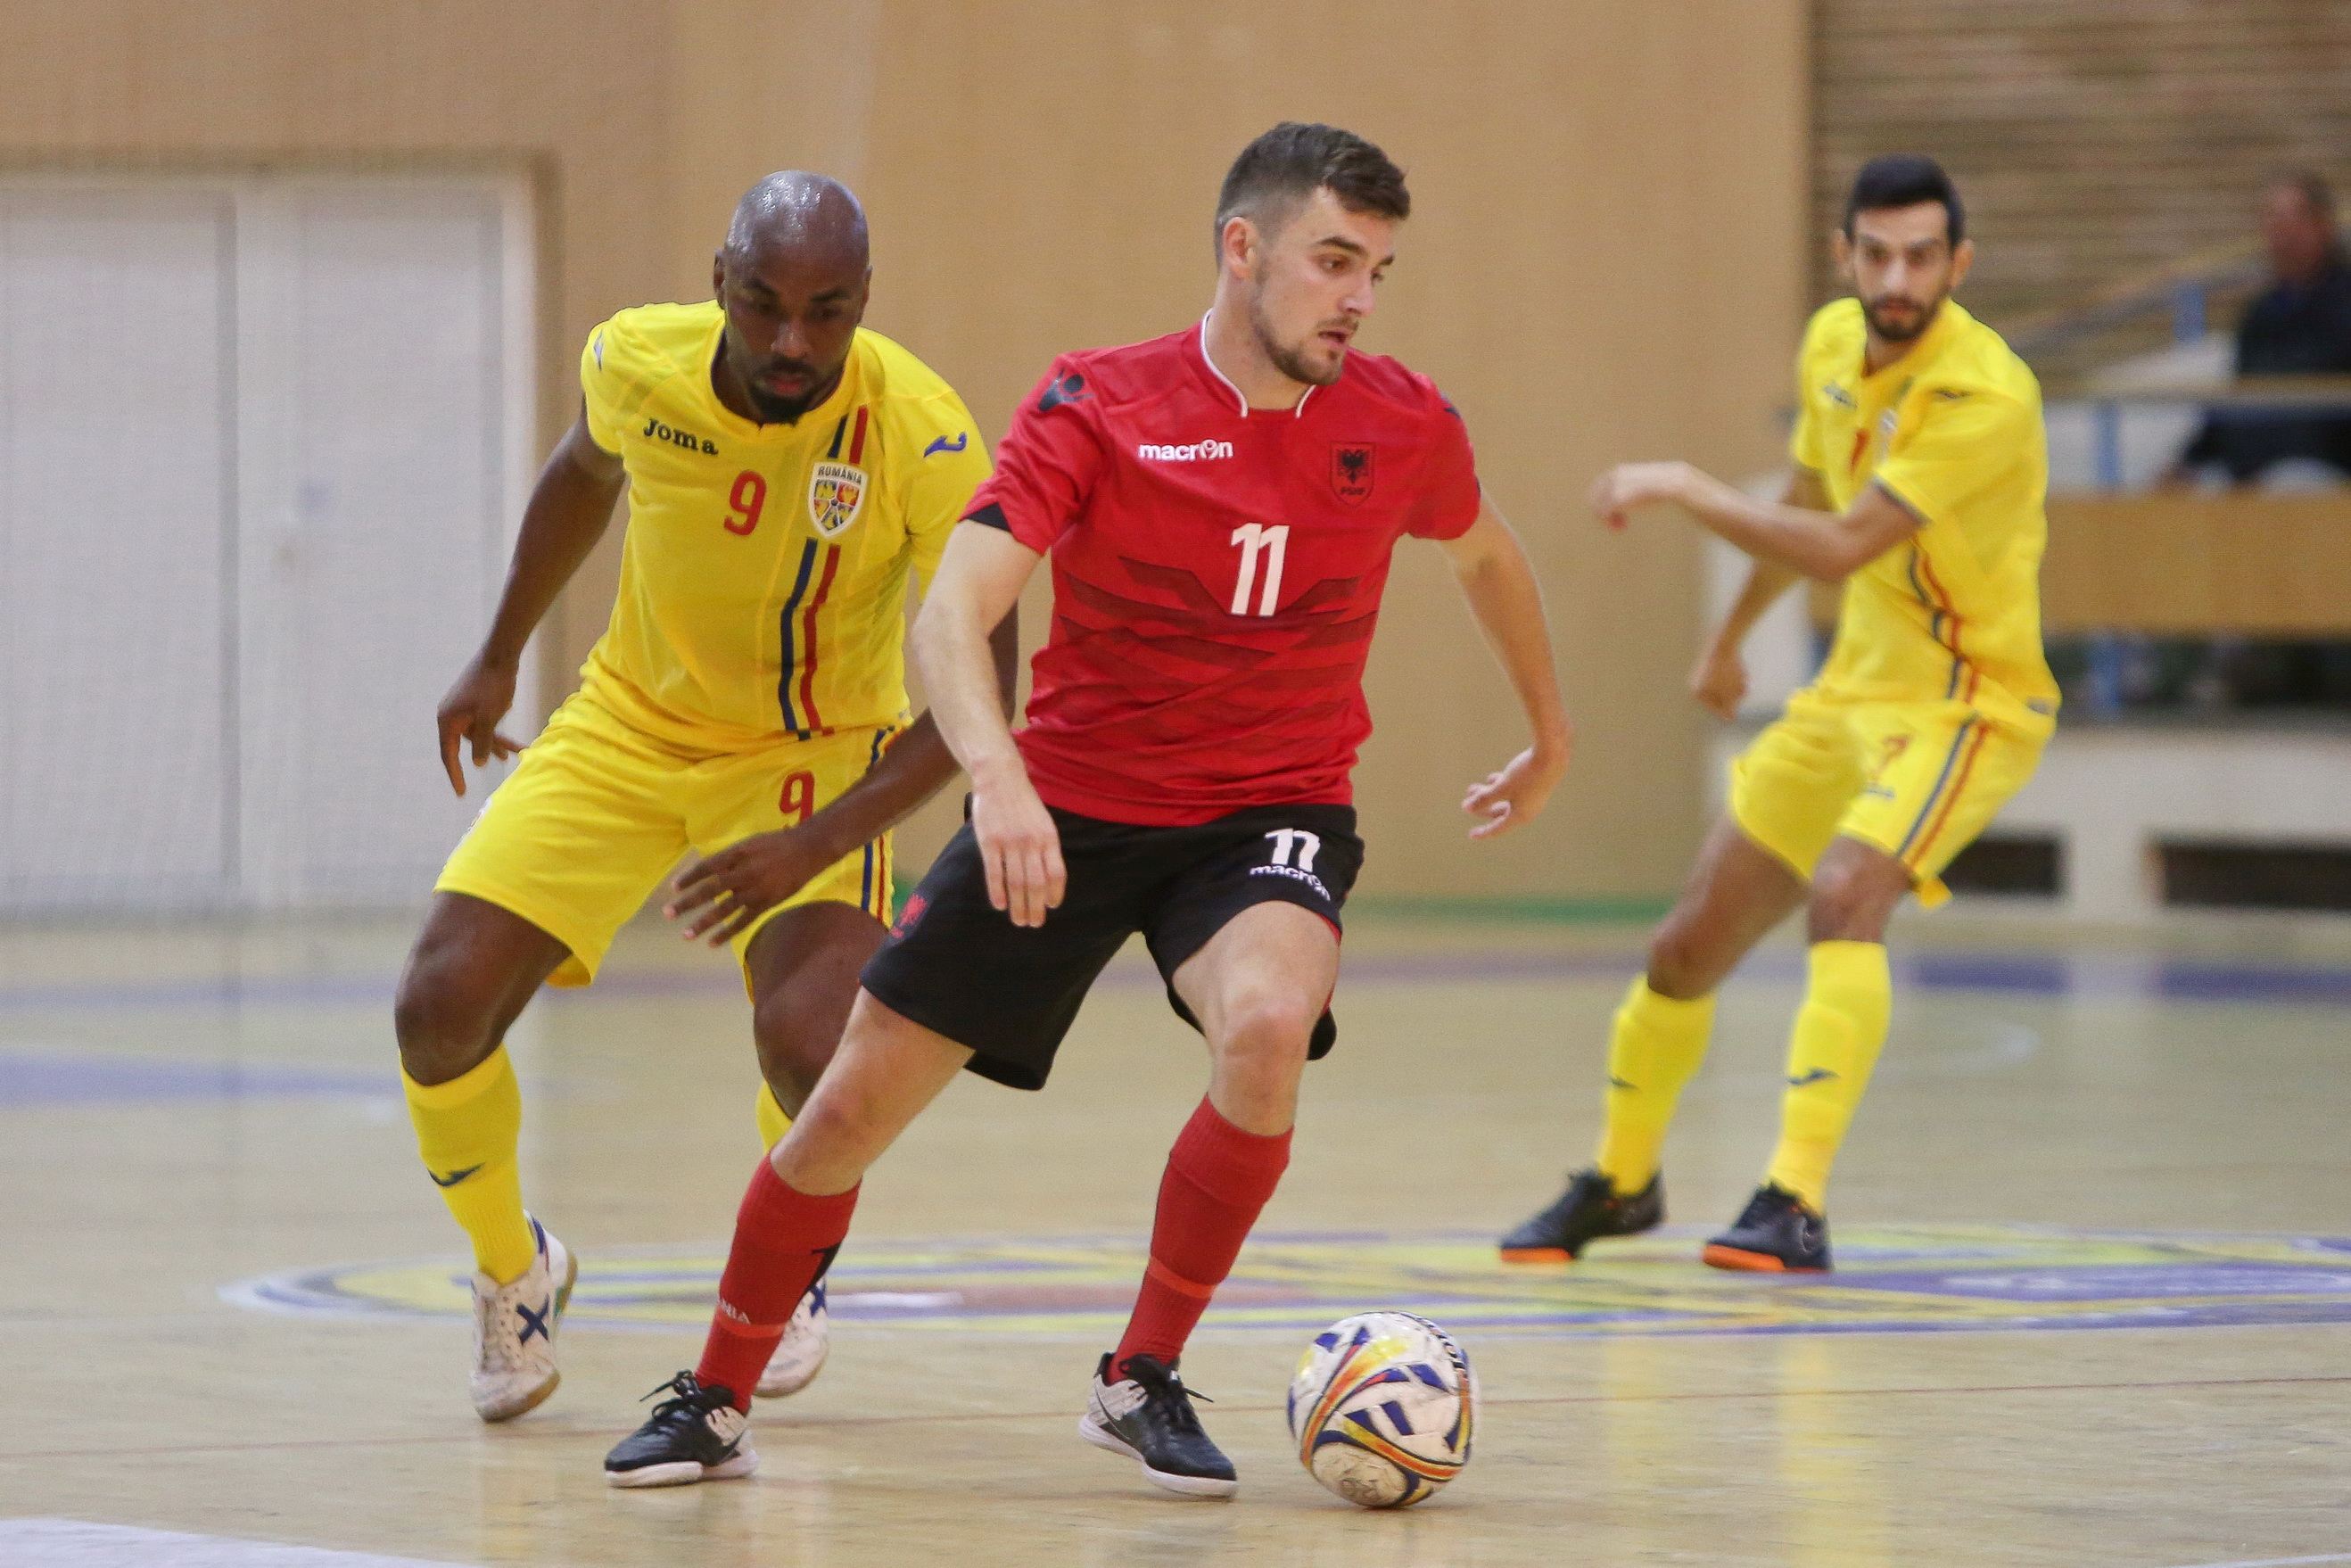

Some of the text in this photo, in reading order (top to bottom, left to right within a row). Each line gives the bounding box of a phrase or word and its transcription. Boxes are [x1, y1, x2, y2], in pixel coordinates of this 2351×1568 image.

[642, 418, 719, 456] Joma
[1138, 439, 1233, 462] macron
[723, 469, 767, 536] 9
[1230, 522, 1291, 617] 11
[779, 770, 815, 831] 9
[1264, 828, 1321, 873] 11
